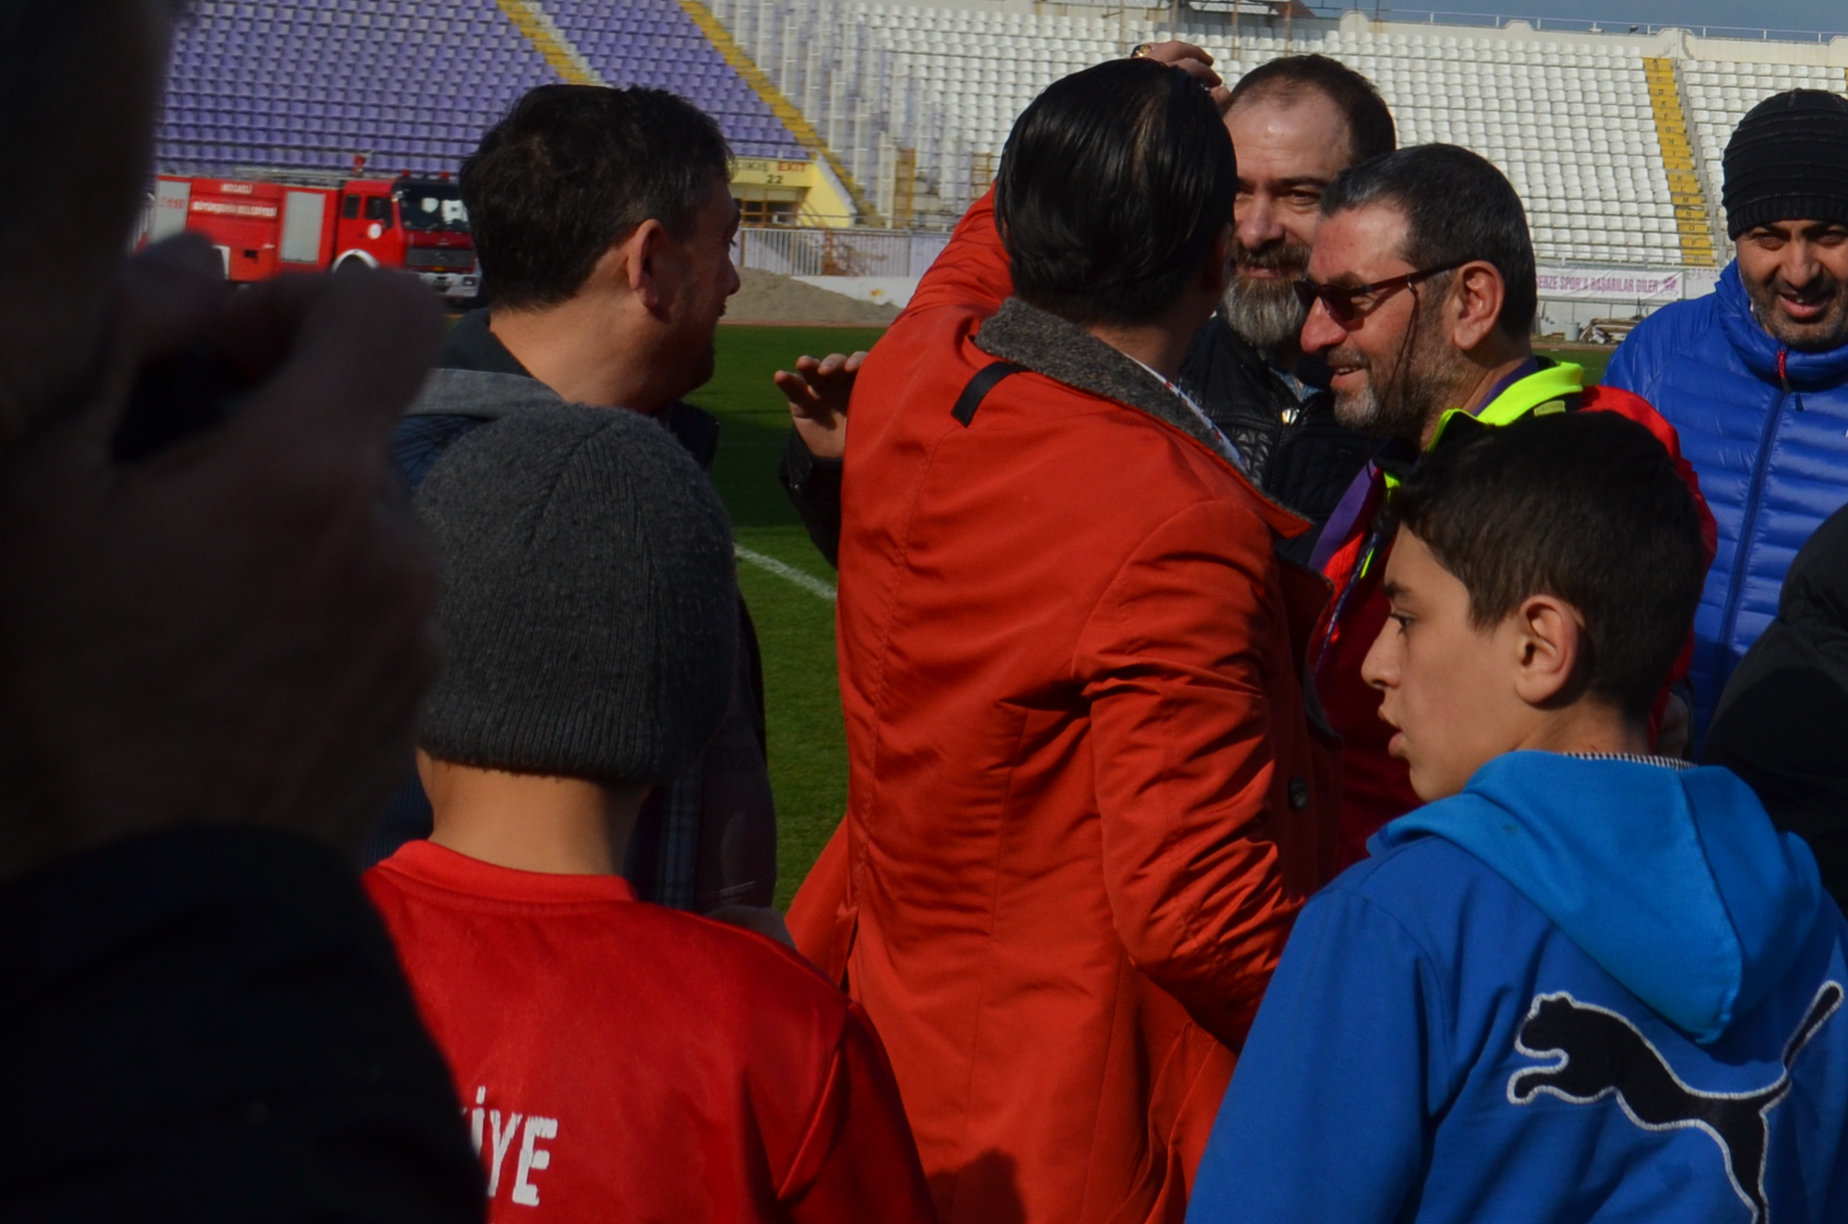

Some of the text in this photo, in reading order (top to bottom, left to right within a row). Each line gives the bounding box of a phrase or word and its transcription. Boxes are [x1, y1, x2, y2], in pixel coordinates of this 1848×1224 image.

[767, 174, 783, 184] 22
[1537, 274, 1558, 290] EBZE
[463, 1085, 559, 1207] İYE
